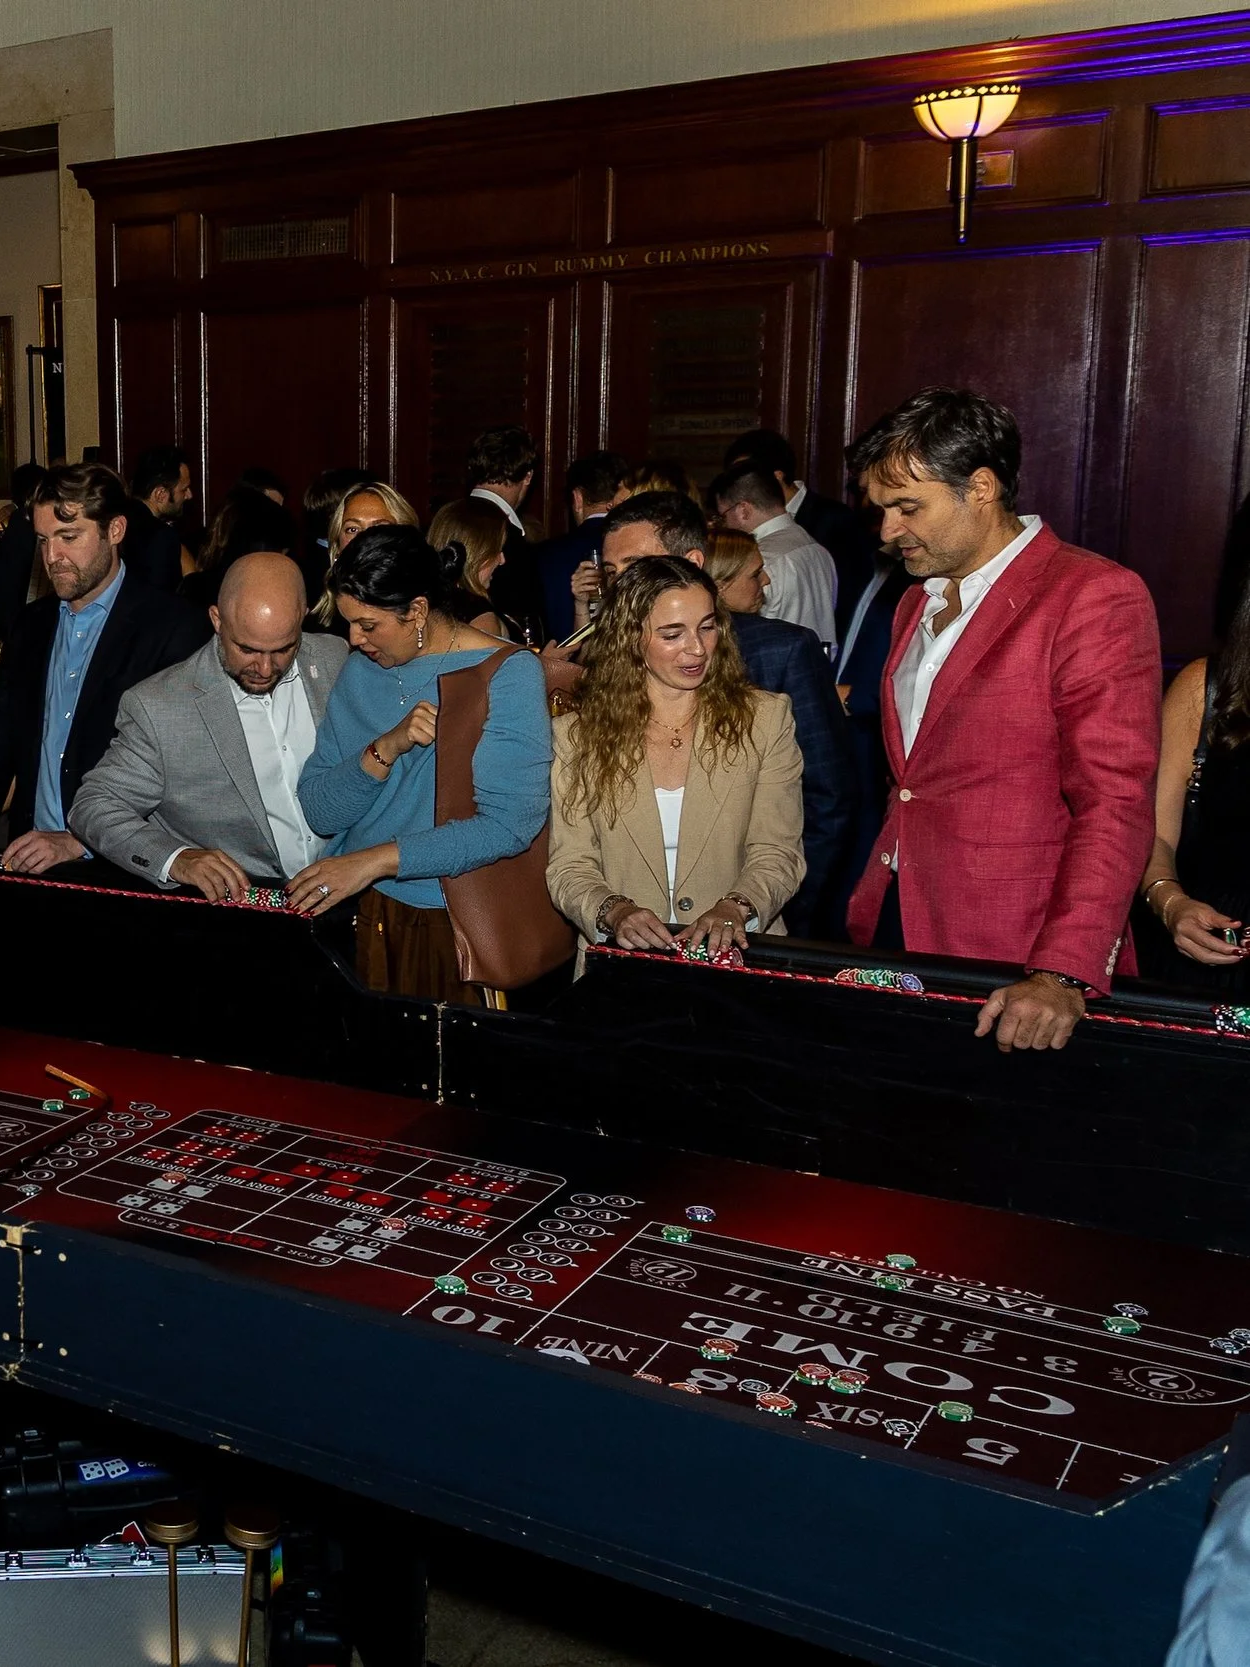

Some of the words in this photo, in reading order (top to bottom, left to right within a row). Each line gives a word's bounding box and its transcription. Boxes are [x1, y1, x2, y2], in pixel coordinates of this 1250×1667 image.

[504, 261, 538, 277] GIN
[554, 253, 630, 273] RUMMY
[645, 241, 771, 266] CHAMPIONS
[126, 1155, 158, 1168] HIGH
[160, 1161, 193, 1174] HORN
[485, 1163, 516, 1174] FOR
[211, 1173, 244, 1187] HIGH
[469, 1169, 500, 1180] FOR
[245, 1180, 284, 1194] HORN
[445, 1187, 475, 1197] FOR
[148, 1191, 174, 1203] FOR
[305, 1193, 343, 1206] HIGH
[345, 1200, 384, 1214] HORN
[139, 1215, 167, 1226] FOR
[403, 1214, 444, 1229] HIGH
[445, 1223, 487, 1238] HORN
[334, 1233, 365, 1244] FOR
[273, 1245, 284, 1253] 1
[286, 1248, 317, 1261] FOR
[645, 1261, 693, 1280] 12
[915, 1268, 987, 1287] CALL
[724, 1282, 771, 1304] 11
[996, 1285, 1045, 1300] NO
[932, 1283, 1060, 1319] PASS
[431, 1305, 516, 1337] 10
[798, 1303, 862, 1326] 10
[807, 1293, 999, 1342] FIELD
[882, 1322, 918, 1340] 9
[961, 1338, 997, 1354] 4
[680, 1311, 1077, 1416] COME
[1043, 1355, 1077, 1374] 3
[686, 1368, 739, 1392] 8
[1148, 1370, 1180, 1391] 2
[807, 1401, 885, 1427] SIX
[962, 1437, 1021, 1466] 5
